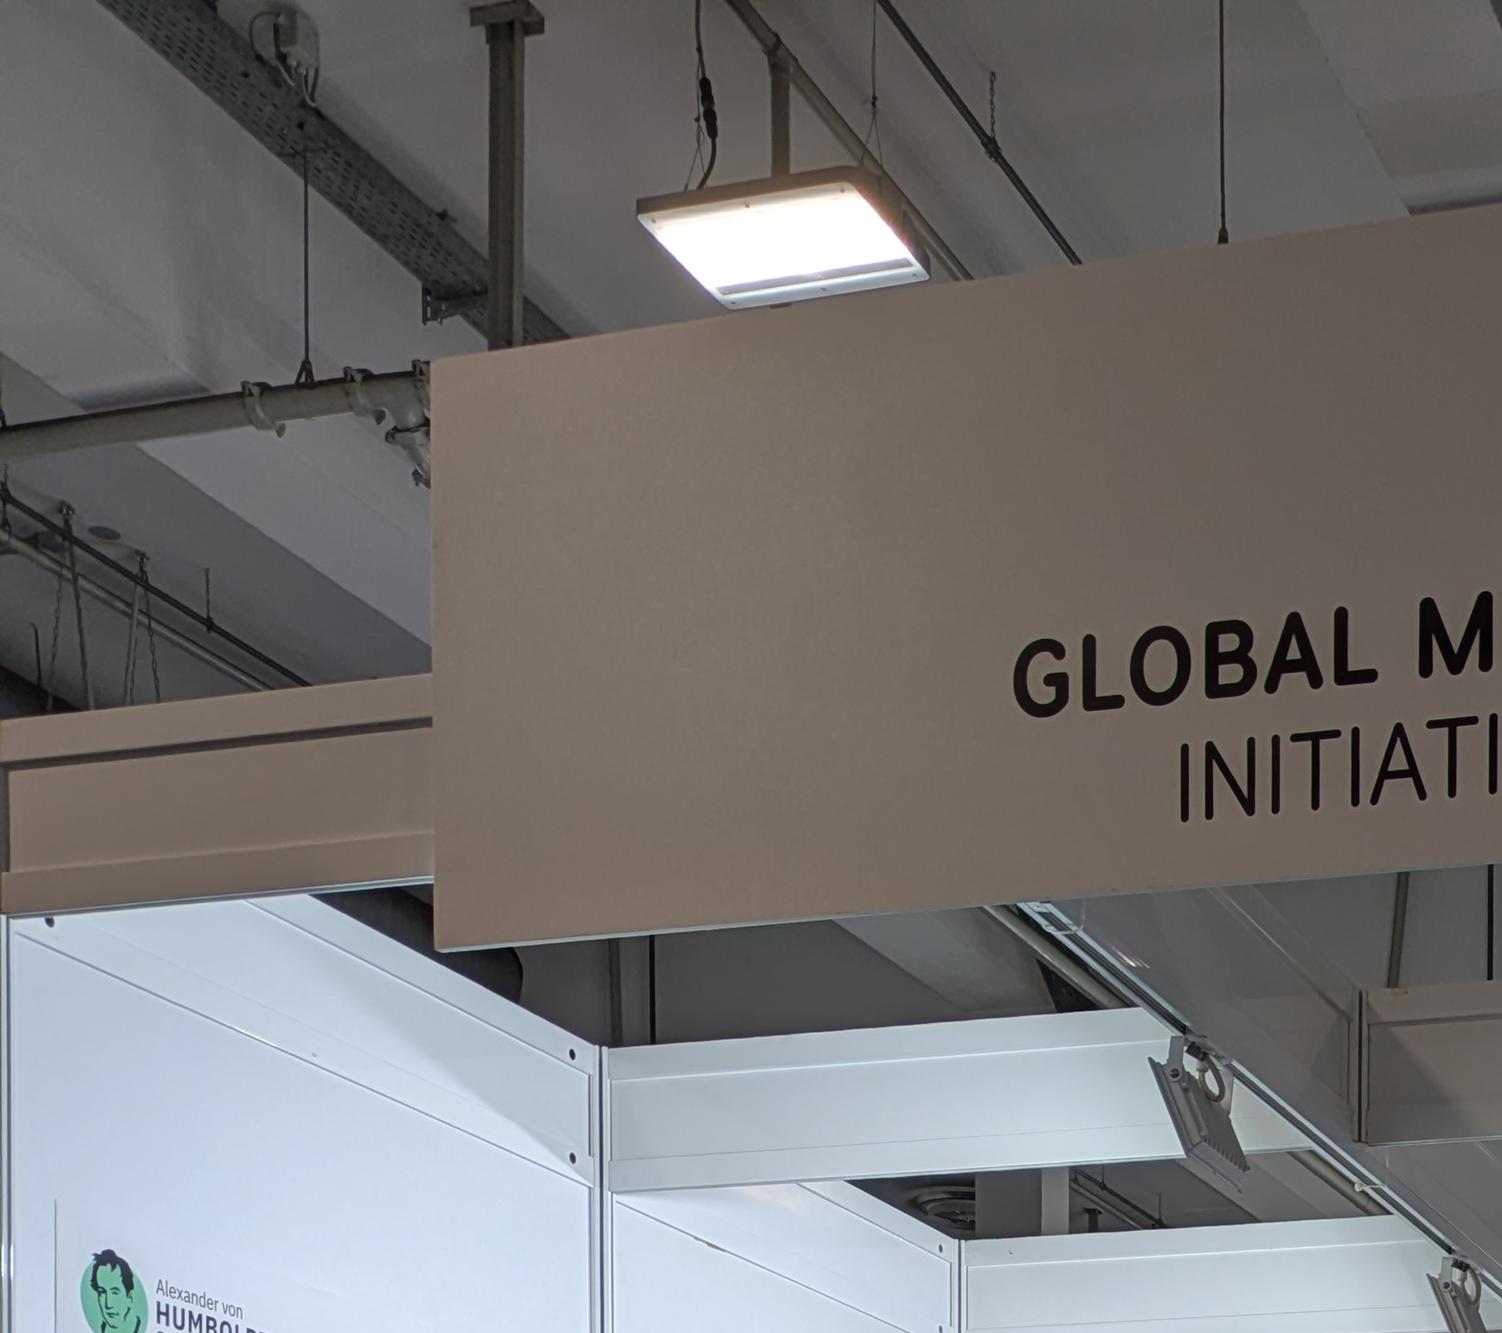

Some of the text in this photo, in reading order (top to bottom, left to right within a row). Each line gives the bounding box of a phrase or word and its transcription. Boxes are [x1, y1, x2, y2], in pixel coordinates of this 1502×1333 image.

[1013, 605, 1379, 718] GLOBAL
[156, 1278, 243, 1319] Alexander von
